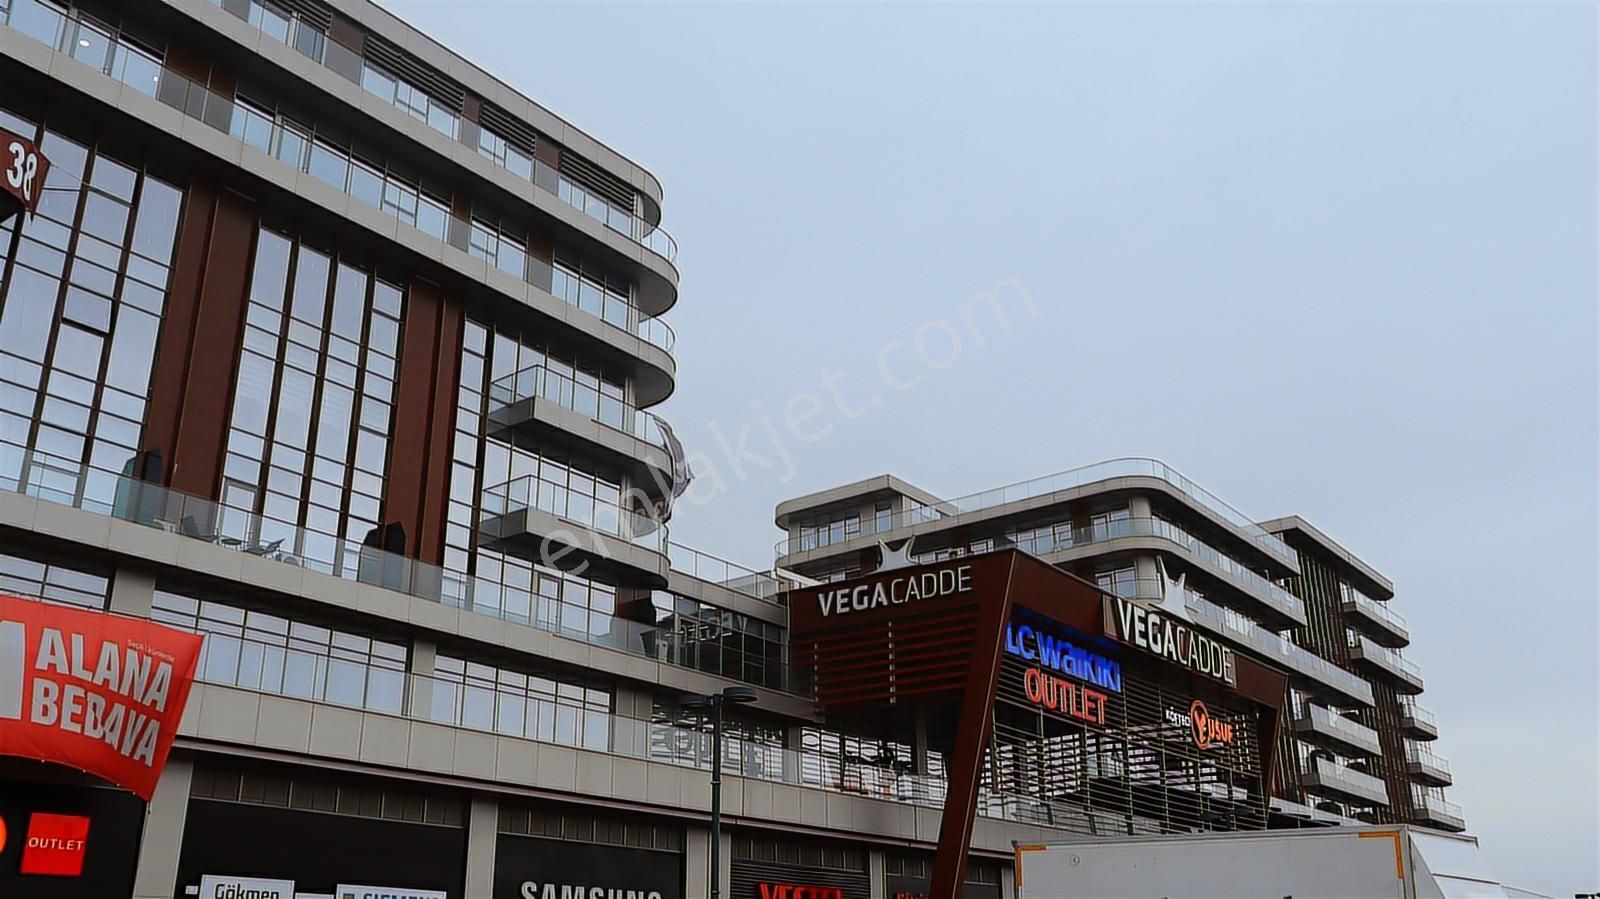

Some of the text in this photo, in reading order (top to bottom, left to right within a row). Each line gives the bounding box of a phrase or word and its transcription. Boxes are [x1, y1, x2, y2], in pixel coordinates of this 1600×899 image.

[7, 142, 37, 201] 38
[35, 627, 173, 712] ALANA
[1024, 668, 1107, 725] OUTLET
[30, 677, 160, 767] BEDAVA
[28, 836, 84, 851] OUTLET
[214, 882, 280, 899] Gökmen
